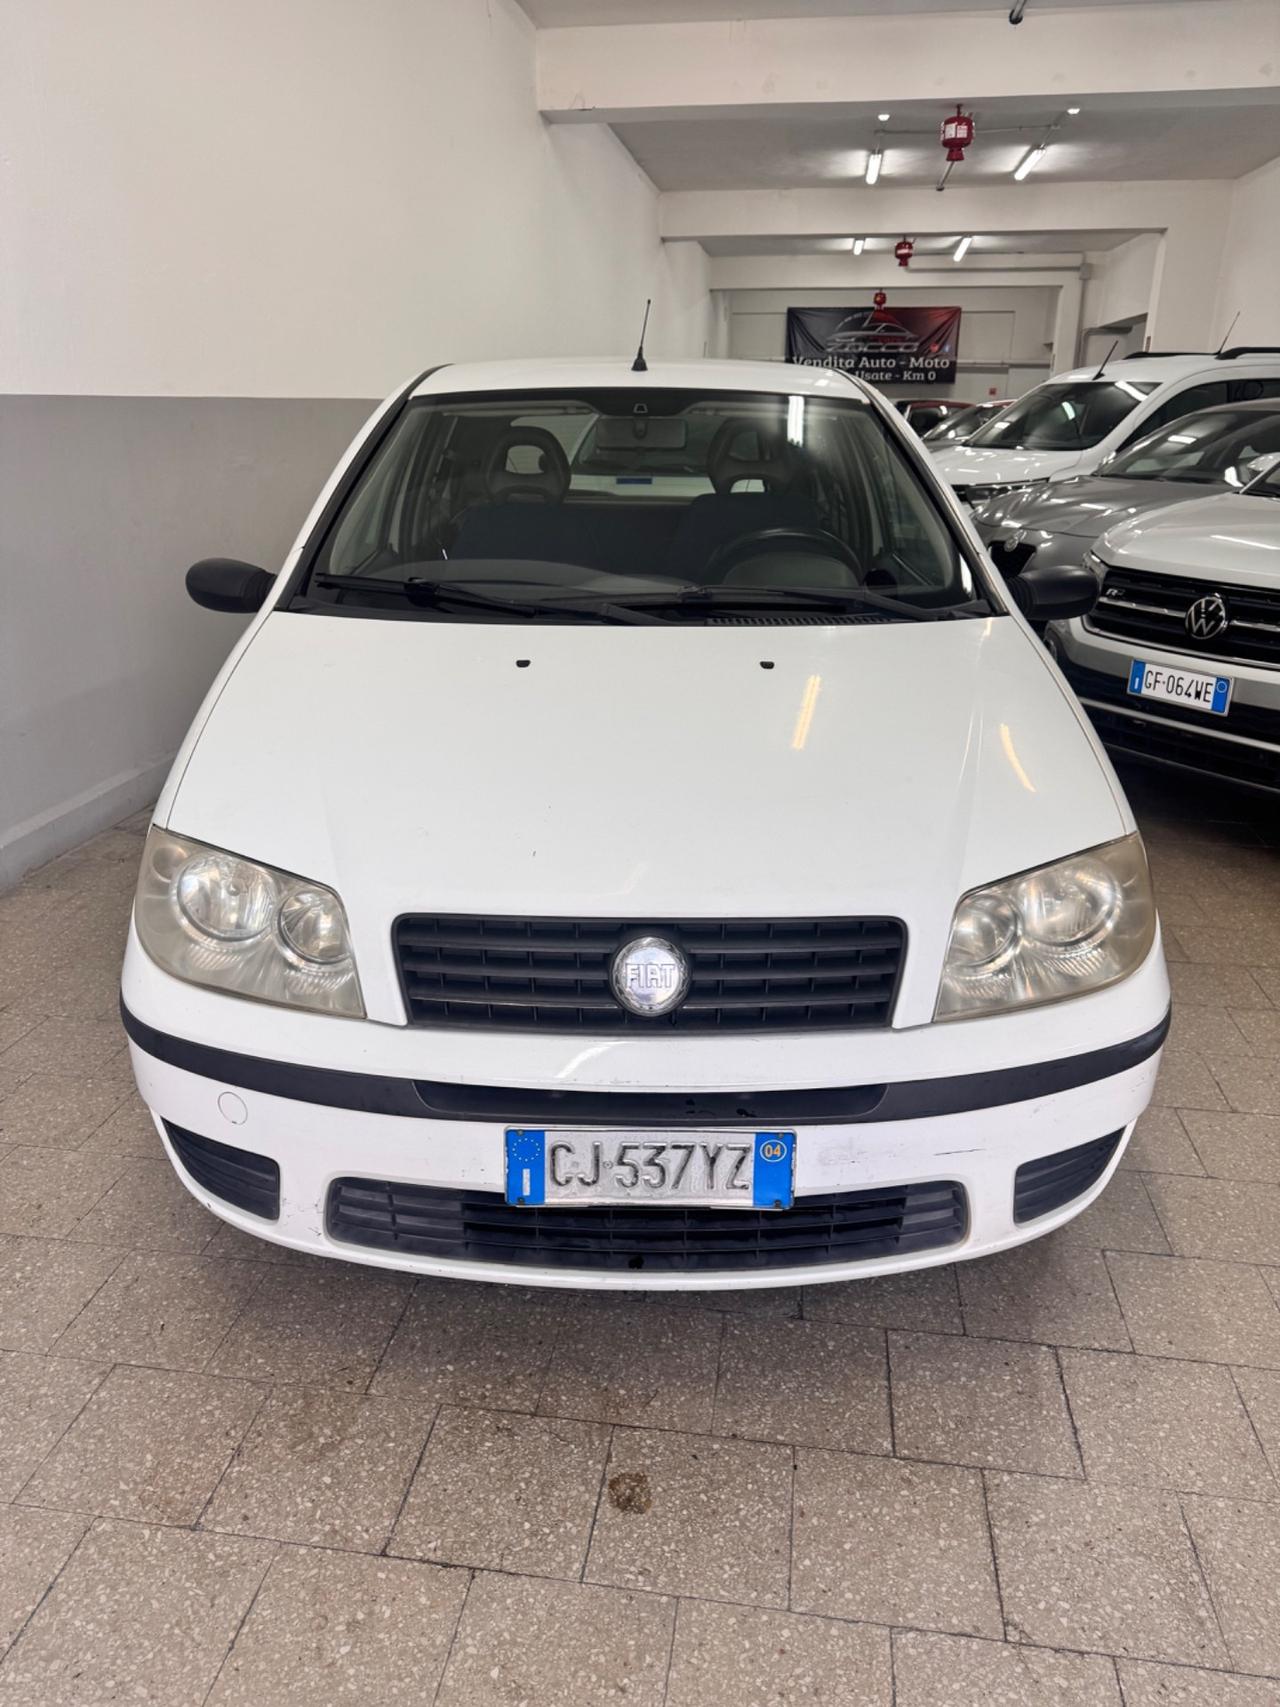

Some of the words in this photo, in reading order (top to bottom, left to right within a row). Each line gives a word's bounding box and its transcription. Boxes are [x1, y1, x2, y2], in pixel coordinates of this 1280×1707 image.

[792, 355, 855, 368] Vendita
[858, 356, 896, 369] Auto
[909, 356, 950, 369] Moto
[855, 371, 893, 381] Usate
[903, 371, 925, 381] Km
[927, 371, 937, 381] 0
[624, 963, 676, 989] FIAT
[764, 1143, 782, 1158] 04
